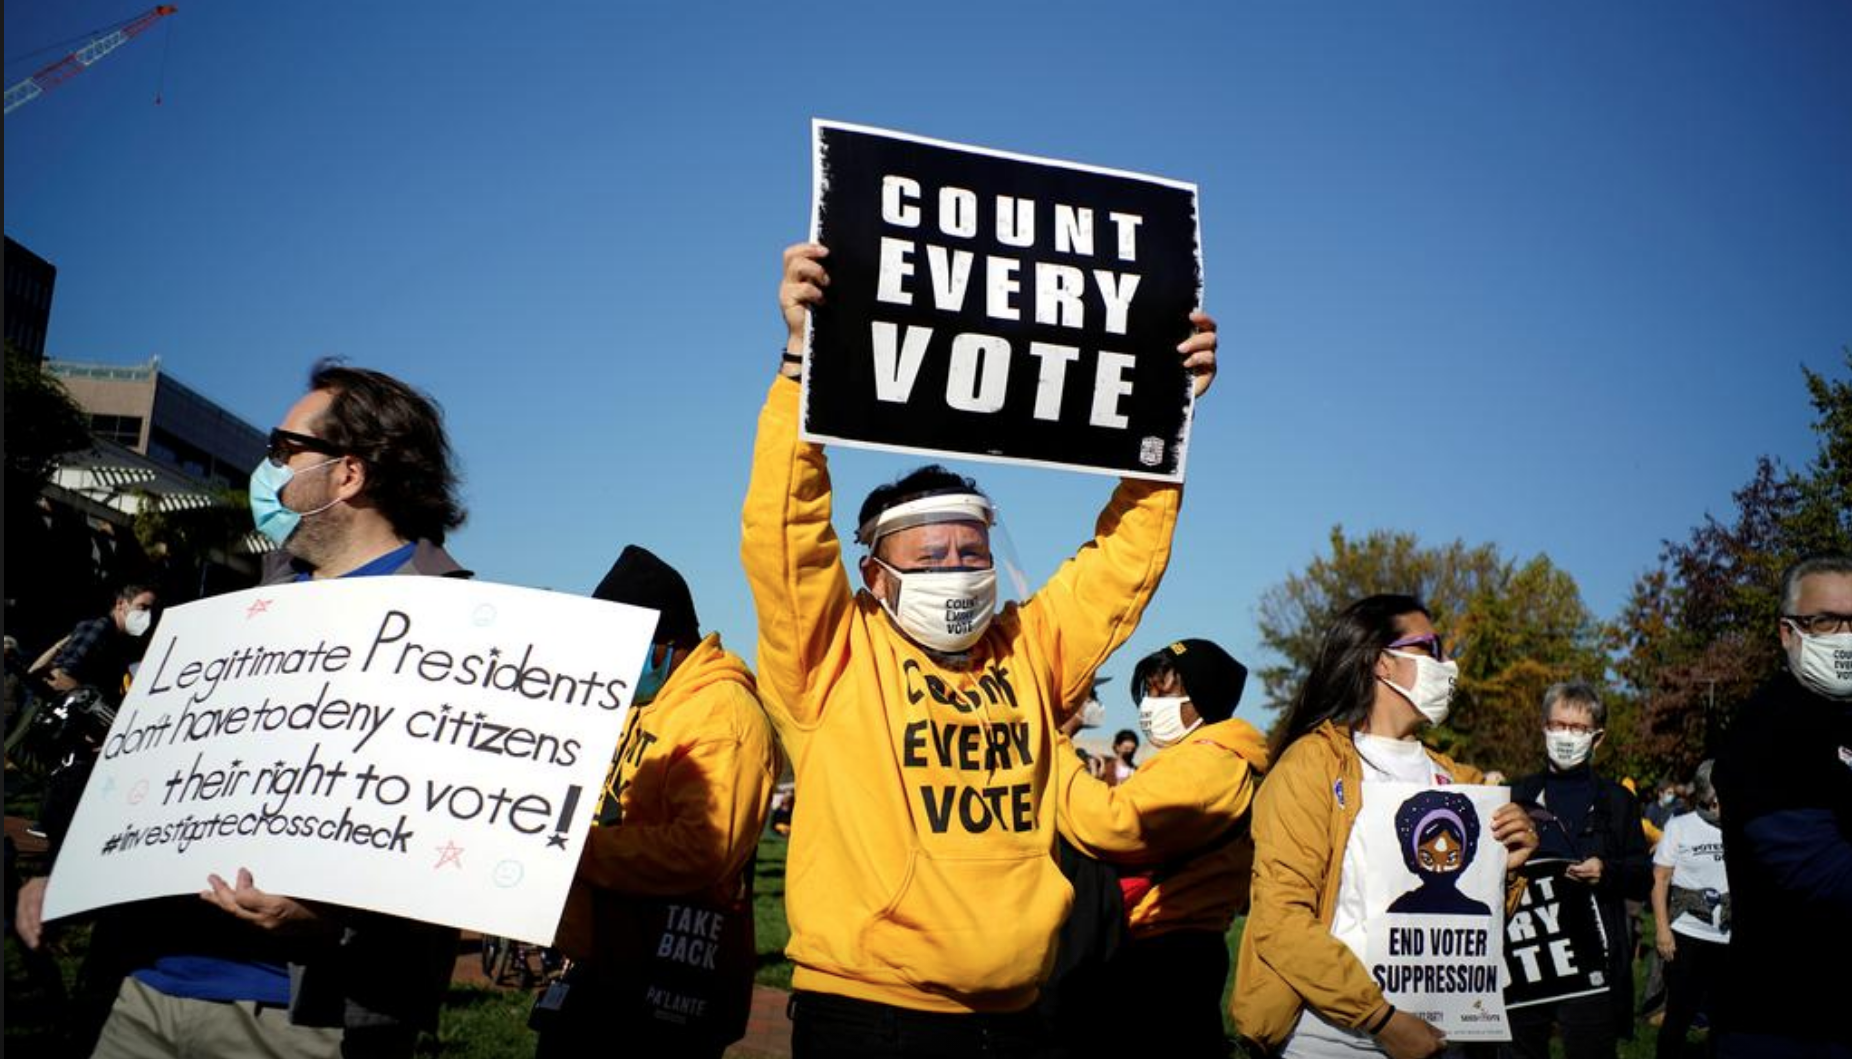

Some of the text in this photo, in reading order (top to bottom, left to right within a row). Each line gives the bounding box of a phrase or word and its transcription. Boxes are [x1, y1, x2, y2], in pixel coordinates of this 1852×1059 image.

[881, 175, 1143, 261] COUNT
[876, 236, 1142, 335] EVERY
[871, 321, 1137, 429] VOTE
[148, 610, 628, 710] Legitimate Presidents
[406, 703, 582, 766] citizens
[903, 719, 1034, 771] EVERY
[163, 752, 250, 805] their
[251, 743, 348, 818] right
[356, 764, 411, 805] to
[427, 780, 583, 851] vote!
[920, 783, 1033, 834] VOTE
[101, 807, 414, 854] #investigatecrosscheck
[667, 905, 724, 941] TAKE
[1389, 928, 1488, 957] END VOTER
[657, 933, 720, 970] BACK
[1503, 938, 1579, 988] TE
[1372, 964, 1498, 994] SUPPRESSION
